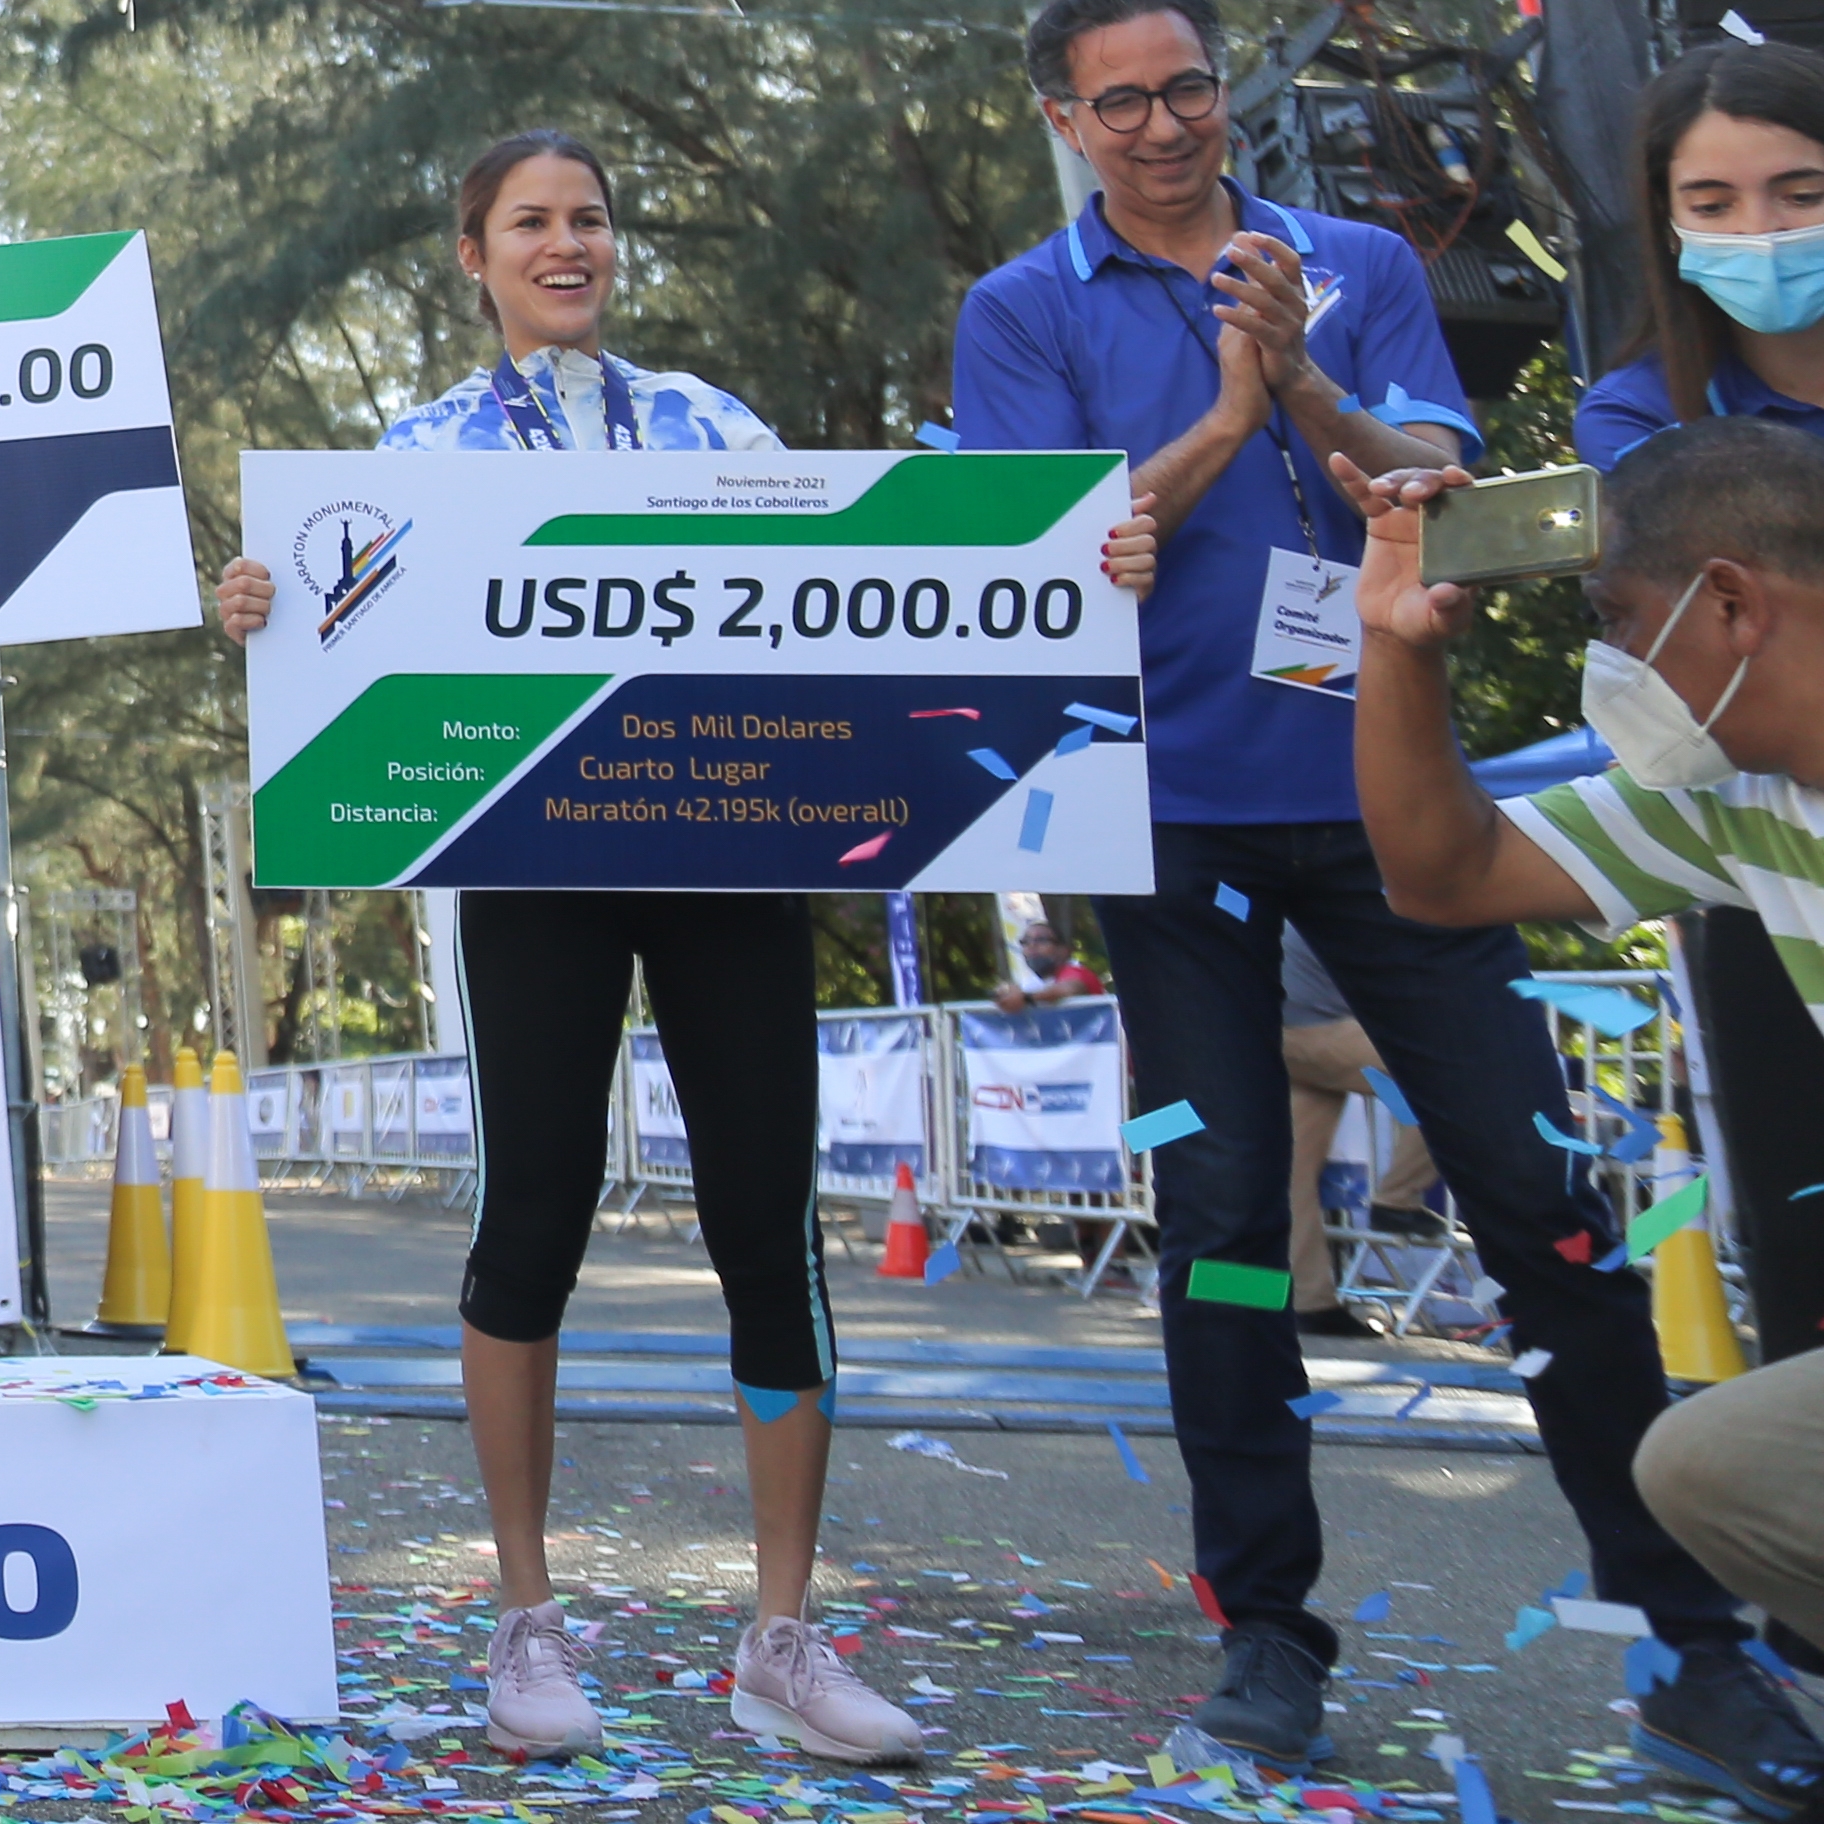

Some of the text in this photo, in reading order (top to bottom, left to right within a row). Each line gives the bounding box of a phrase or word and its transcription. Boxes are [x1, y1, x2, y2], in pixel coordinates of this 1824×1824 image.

[717, 476, 825, 489] Noviembre 2021
[648, 497, 708, 510] Santiago
[711, 497, 728, 507] de
[731, 497, 751, 507] los
[485, 570, 1082, 649] USD$ 2,000.00
[444, 721, 520, 739] Monto:
[623, 715, 852, 739] Dos Mil Dolares
[388, 762, 484, 781] Posición:
[580, 756, 770, 786] Cuarto Lugar
[331, 803, 437, 822] Distancia:
[546, 797, 908, 826] Maratón 42.195k (overall)
